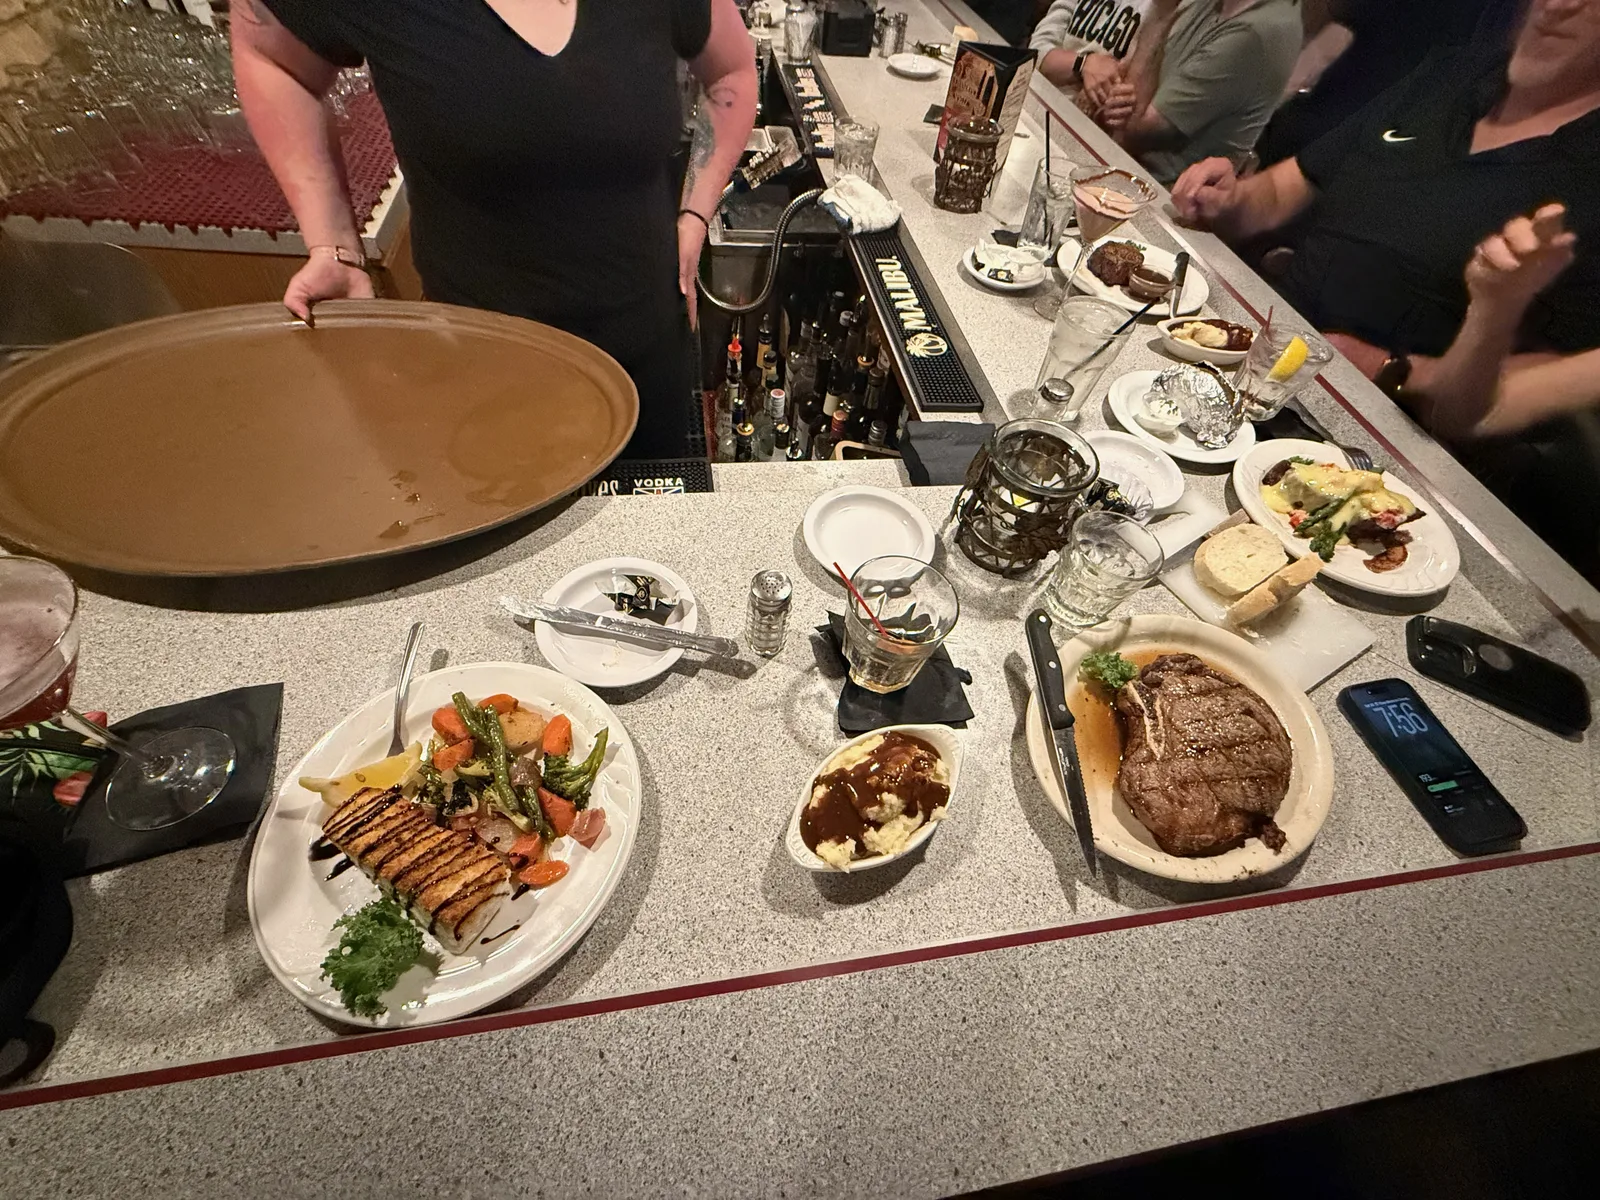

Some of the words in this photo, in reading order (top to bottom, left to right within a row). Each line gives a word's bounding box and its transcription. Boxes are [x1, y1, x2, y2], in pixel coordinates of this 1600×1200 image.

[1067, 0, 1141, 59] HICAGO
[875, 257, 932, 331] MALIBU
[633, 477, 684, 487] VODKA
[1372, 702, 1429, 737] 7:56
